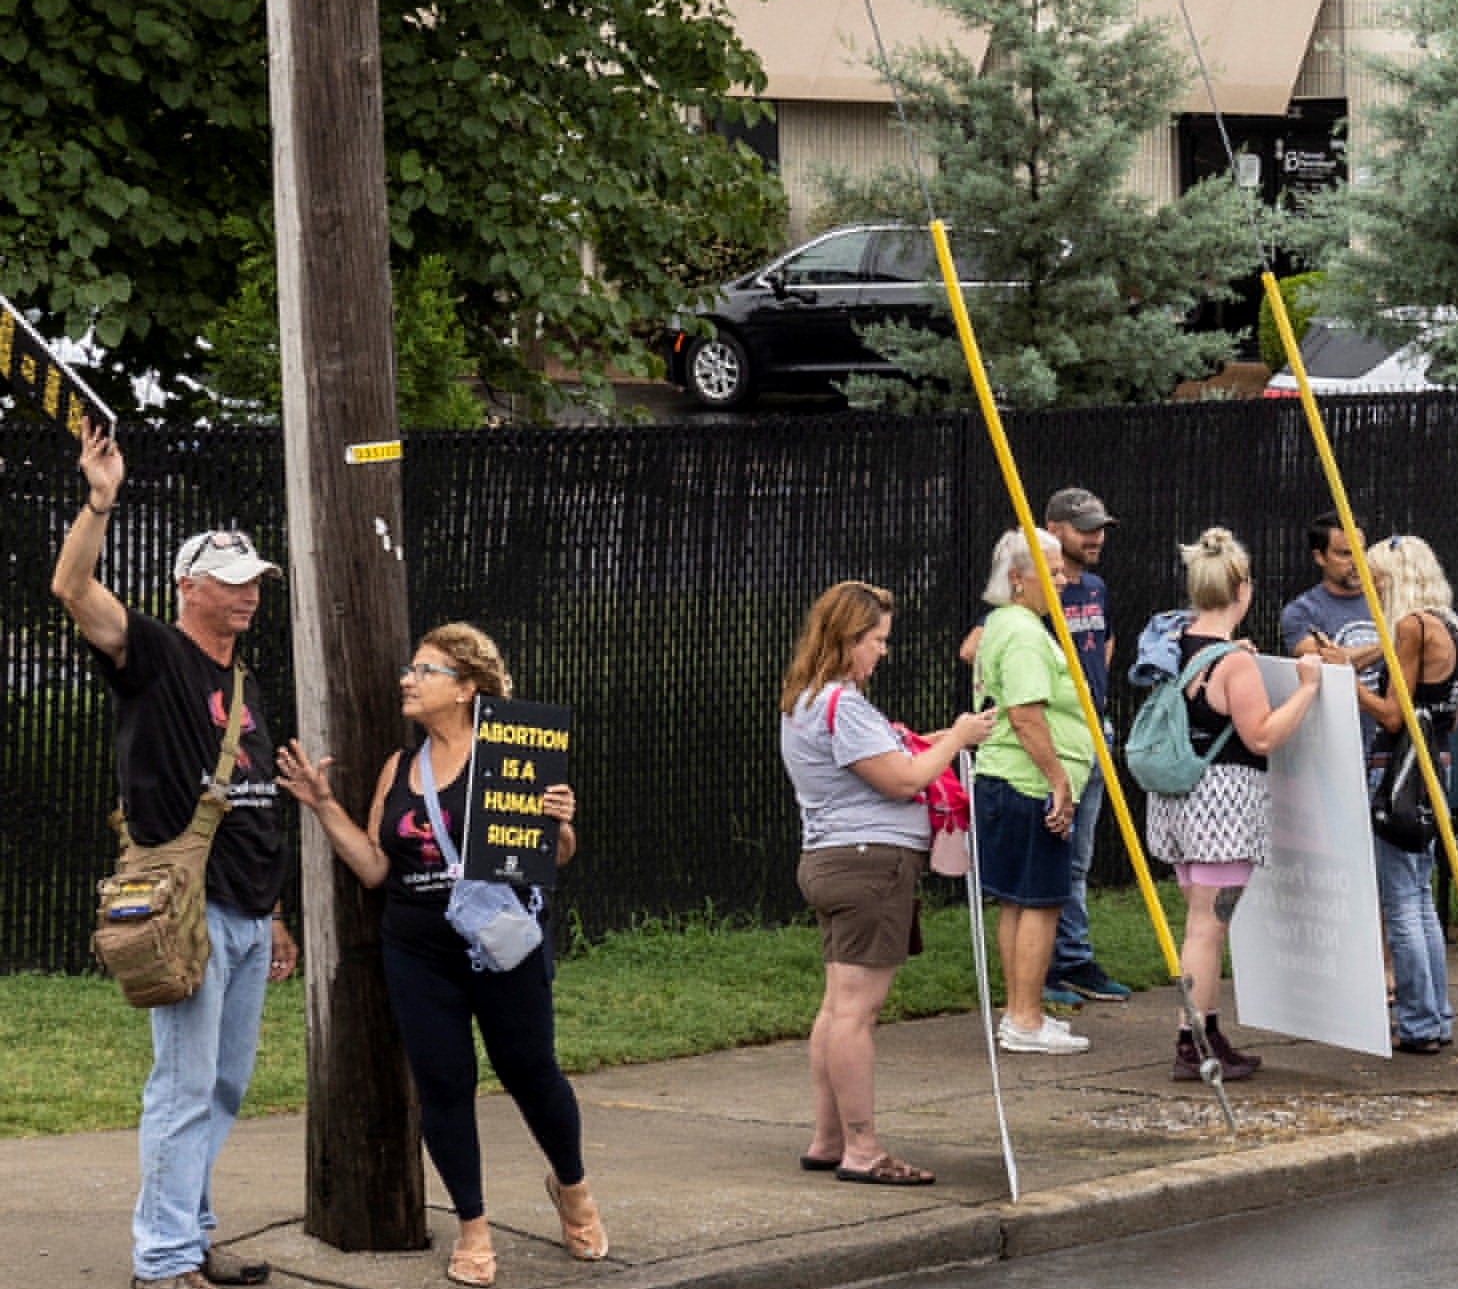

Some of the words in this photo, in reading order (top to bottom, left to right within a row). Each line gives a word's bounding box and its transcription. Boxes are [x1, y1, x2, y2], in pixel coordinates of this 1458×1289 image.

[478, 721, 569, 751] ABORTION
[501, 757, 519, 778] IS
[520, 760, 537, 781] A
[486, 824, 543, 849] RIGHT
